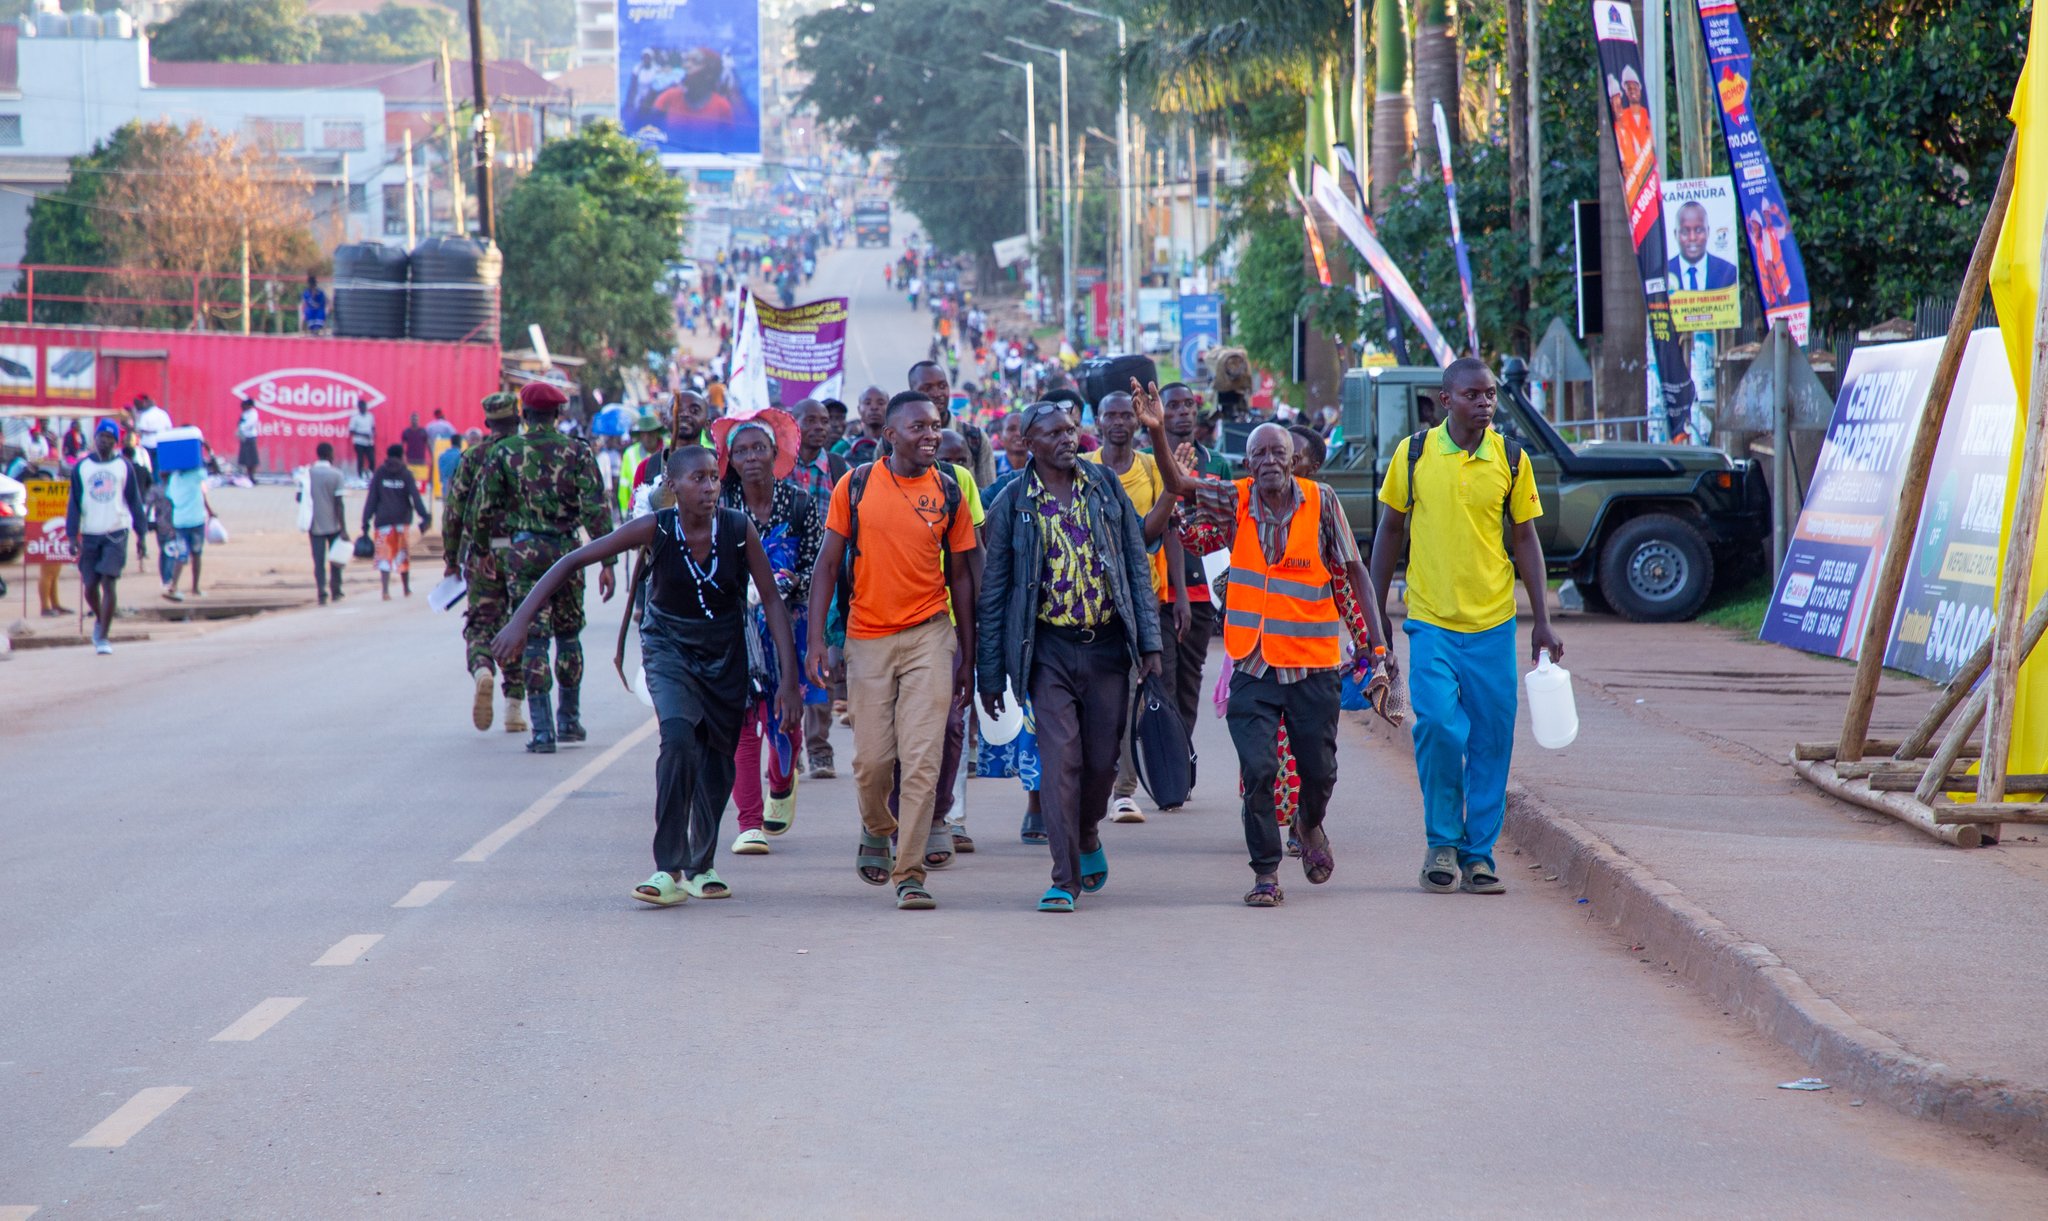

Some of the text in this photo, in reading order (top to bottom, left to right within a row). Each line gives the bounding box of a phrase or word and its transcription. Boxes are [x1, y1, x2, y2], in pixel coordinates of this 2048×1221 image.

[1676, 181, 1708, 189] DANIEL
[1681, 304, 1735, 314] MUNICIPALITY
[258, 381, 359, 408] Sadolin
[1846, 369, 1918, 420] CENTURY
[1824, 422, 1905, 471] PROPERTY
[27, 537, 71, 555] airte
[1283, 558, 1311, 569] JEMIMAH
